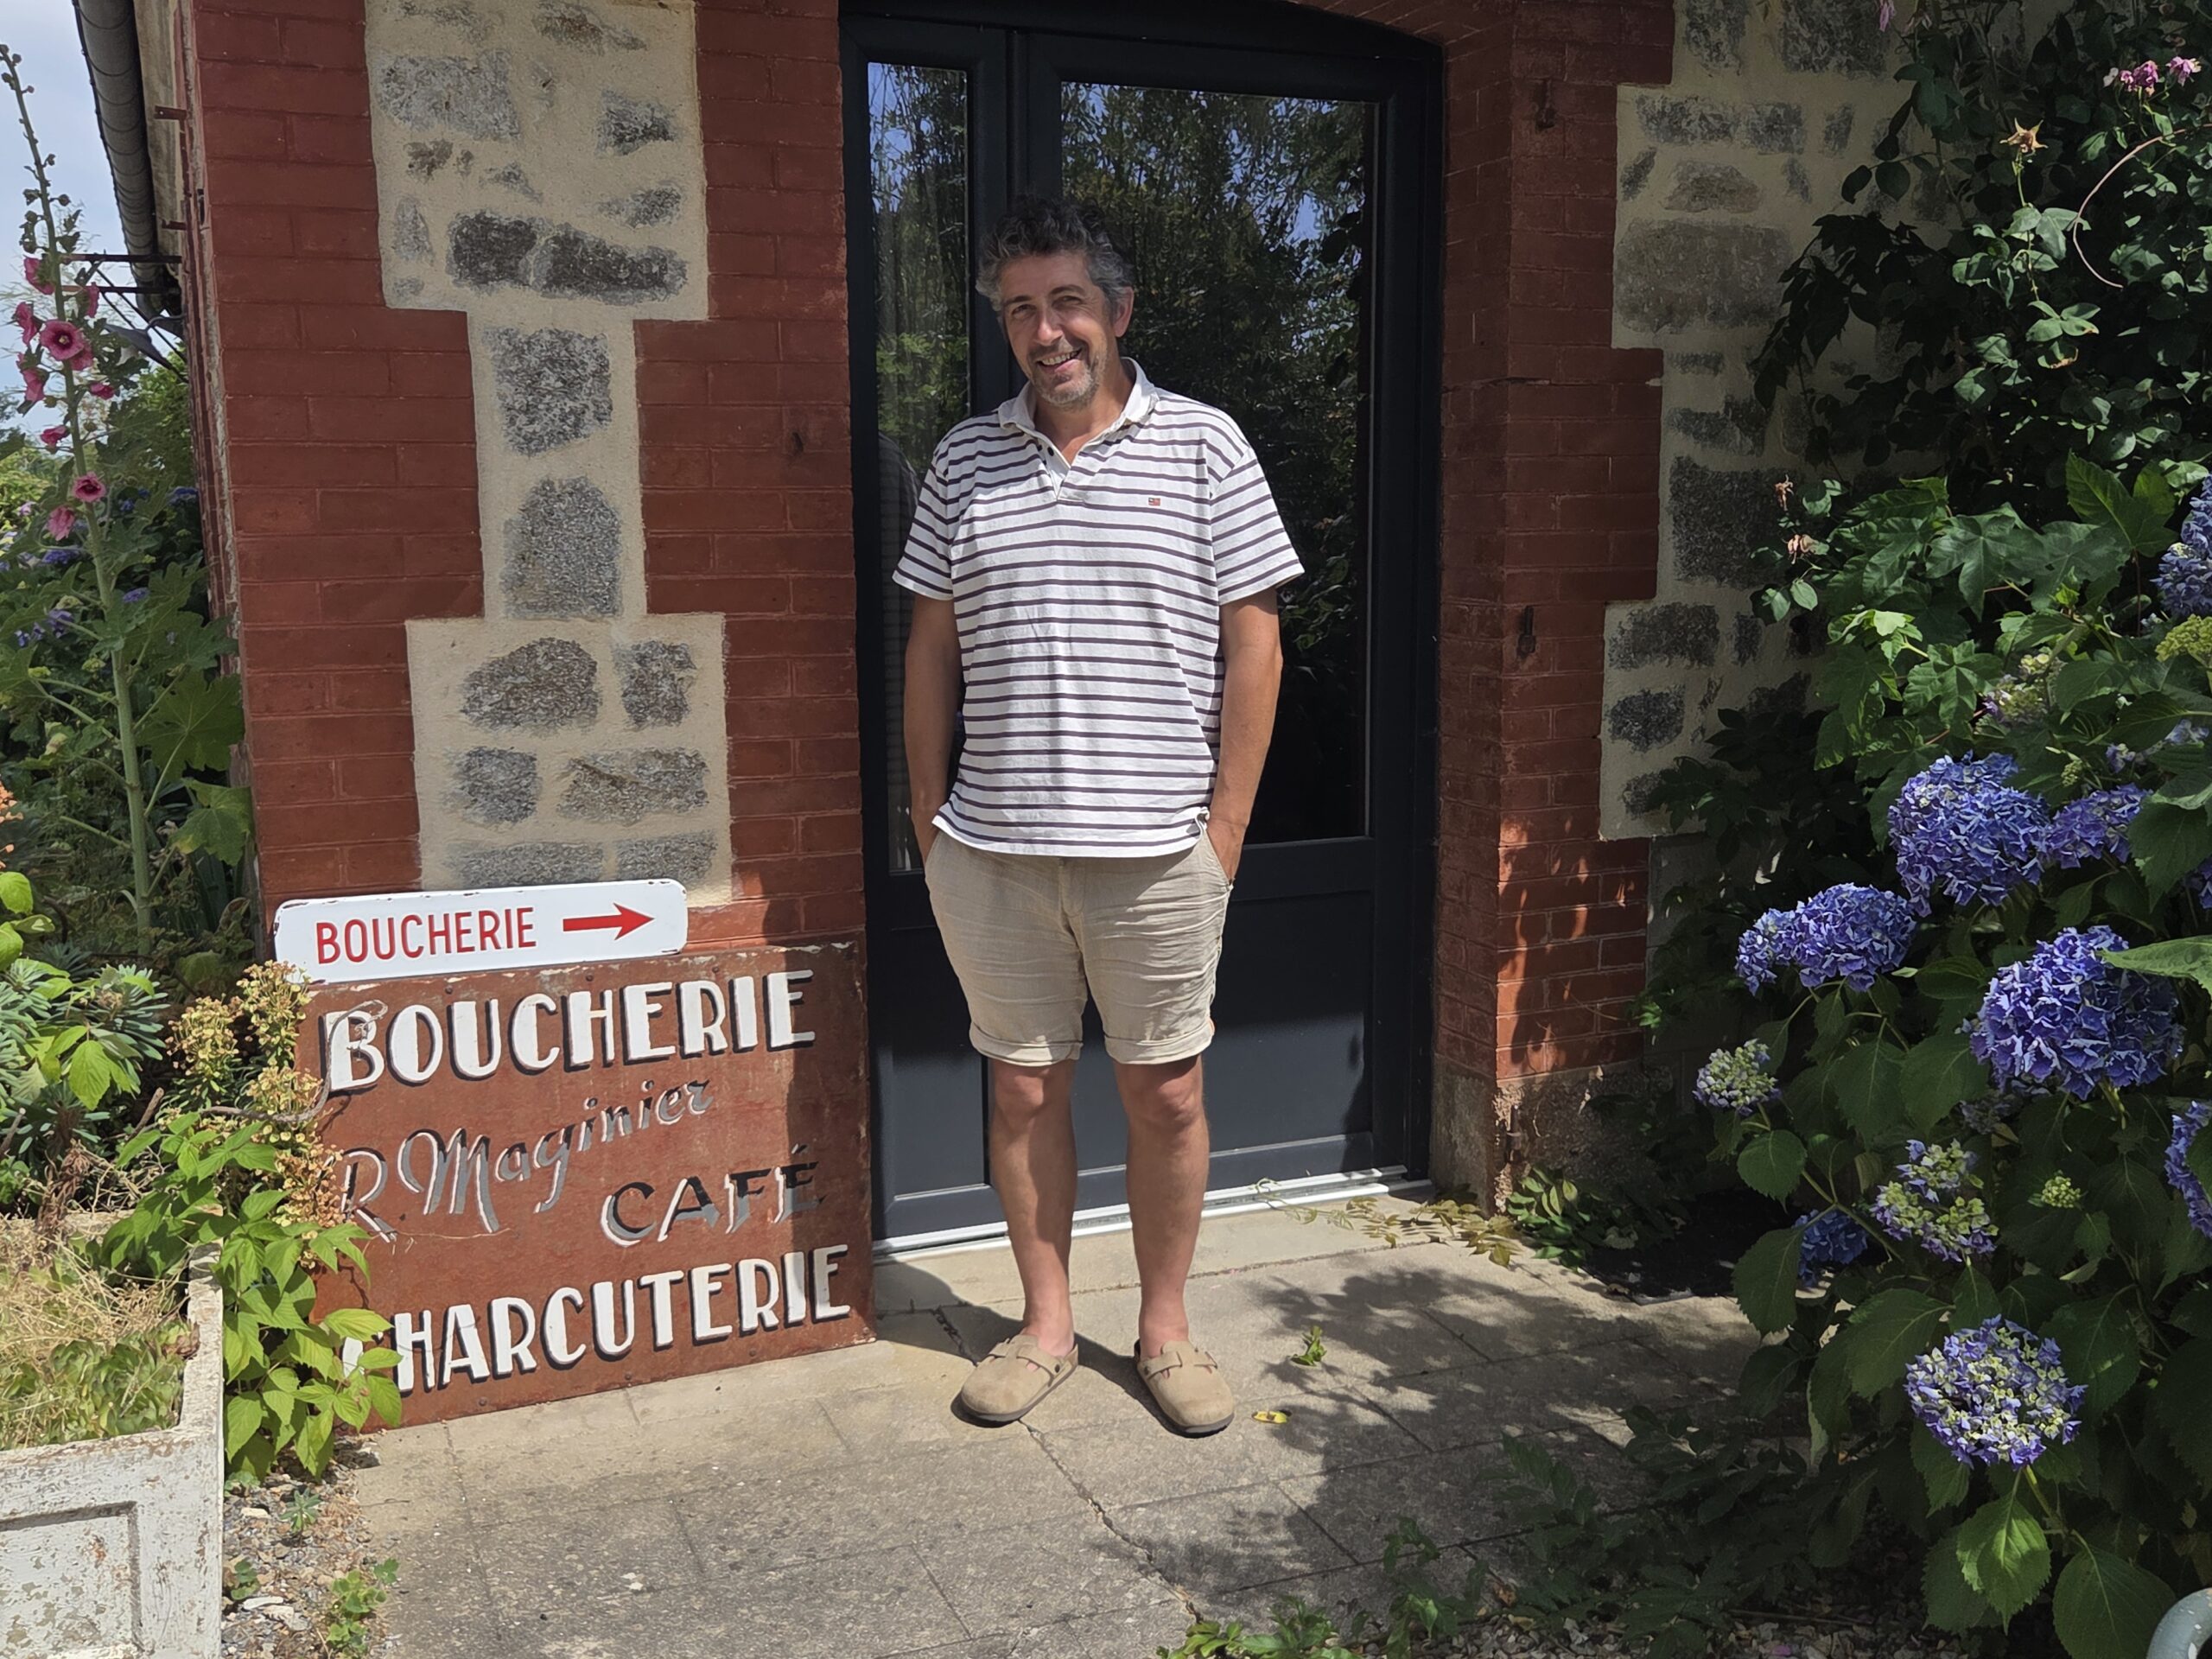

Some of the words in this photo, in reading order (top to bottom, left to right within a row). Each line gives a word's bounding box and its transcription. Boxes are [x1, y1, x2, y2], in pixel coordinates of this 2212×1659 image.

[316, 906, 537, 965] BOUCHERIE
[323, 969, 816, 1095] BOUCHERIE
[397, 1078, 715, 1234] Maginier
[600, 1142, 827, 1248] CAFÉ
